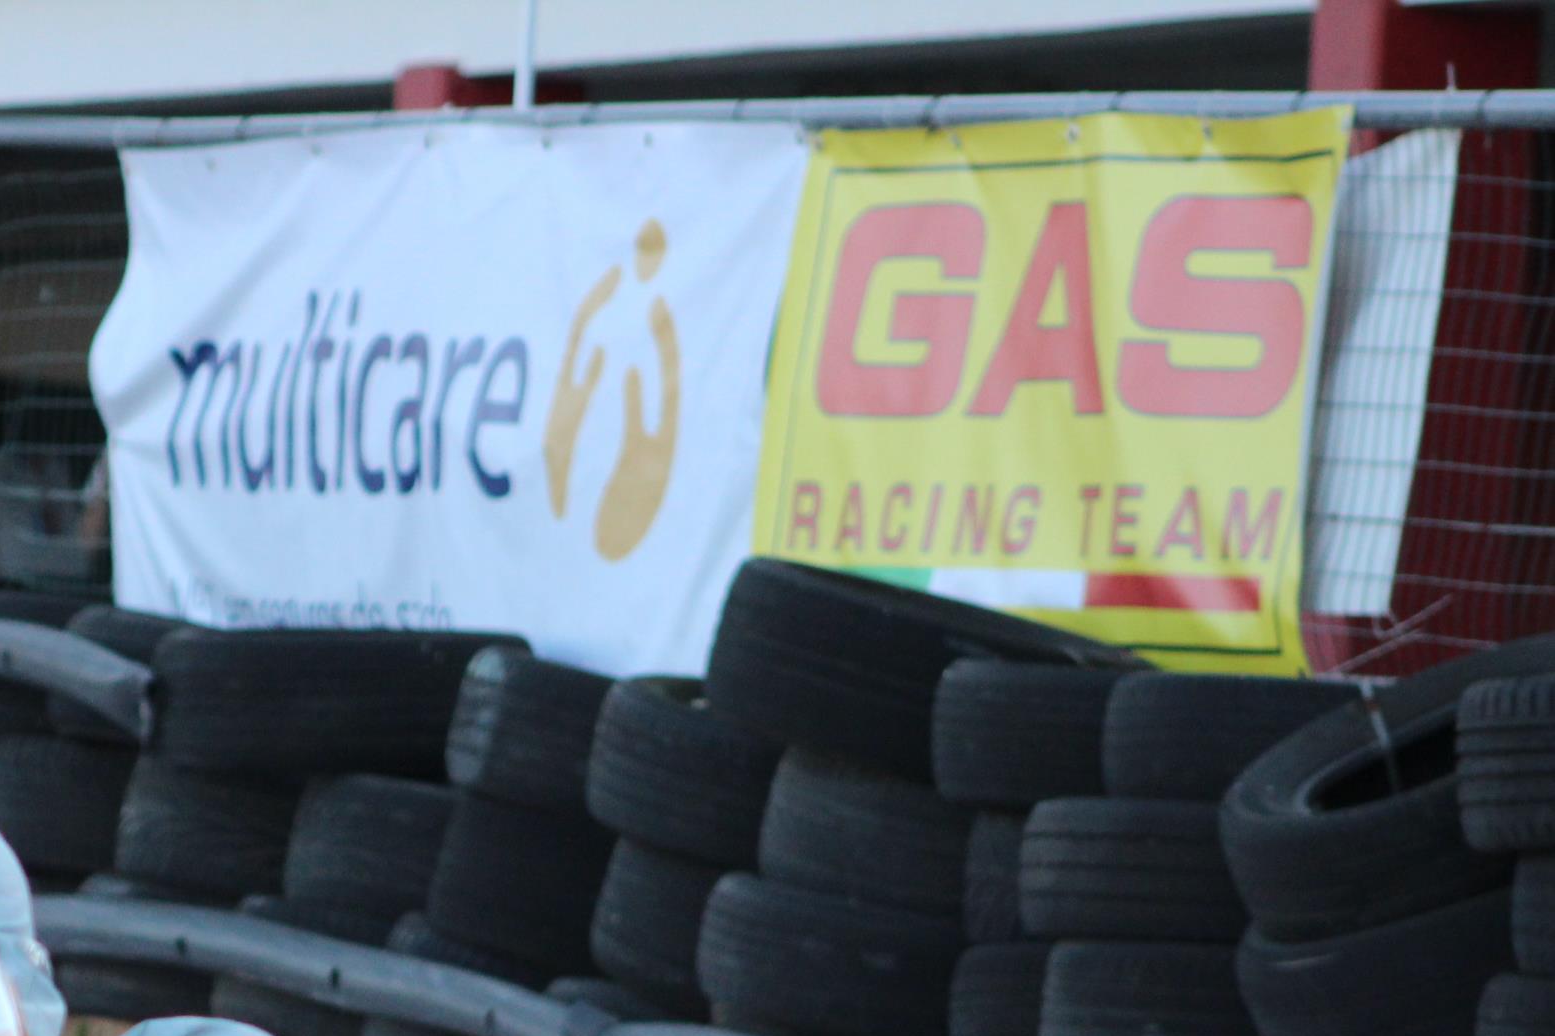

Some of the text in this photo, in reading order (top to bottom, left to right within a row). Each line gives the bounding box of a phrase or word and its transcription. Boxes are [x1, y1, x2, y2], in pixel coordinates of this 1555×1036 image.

[165, 289, 529, 498] multicare
[815, 193, 1313, 419] GAS
[786, 482, 1285, 562] RACING TEAM
